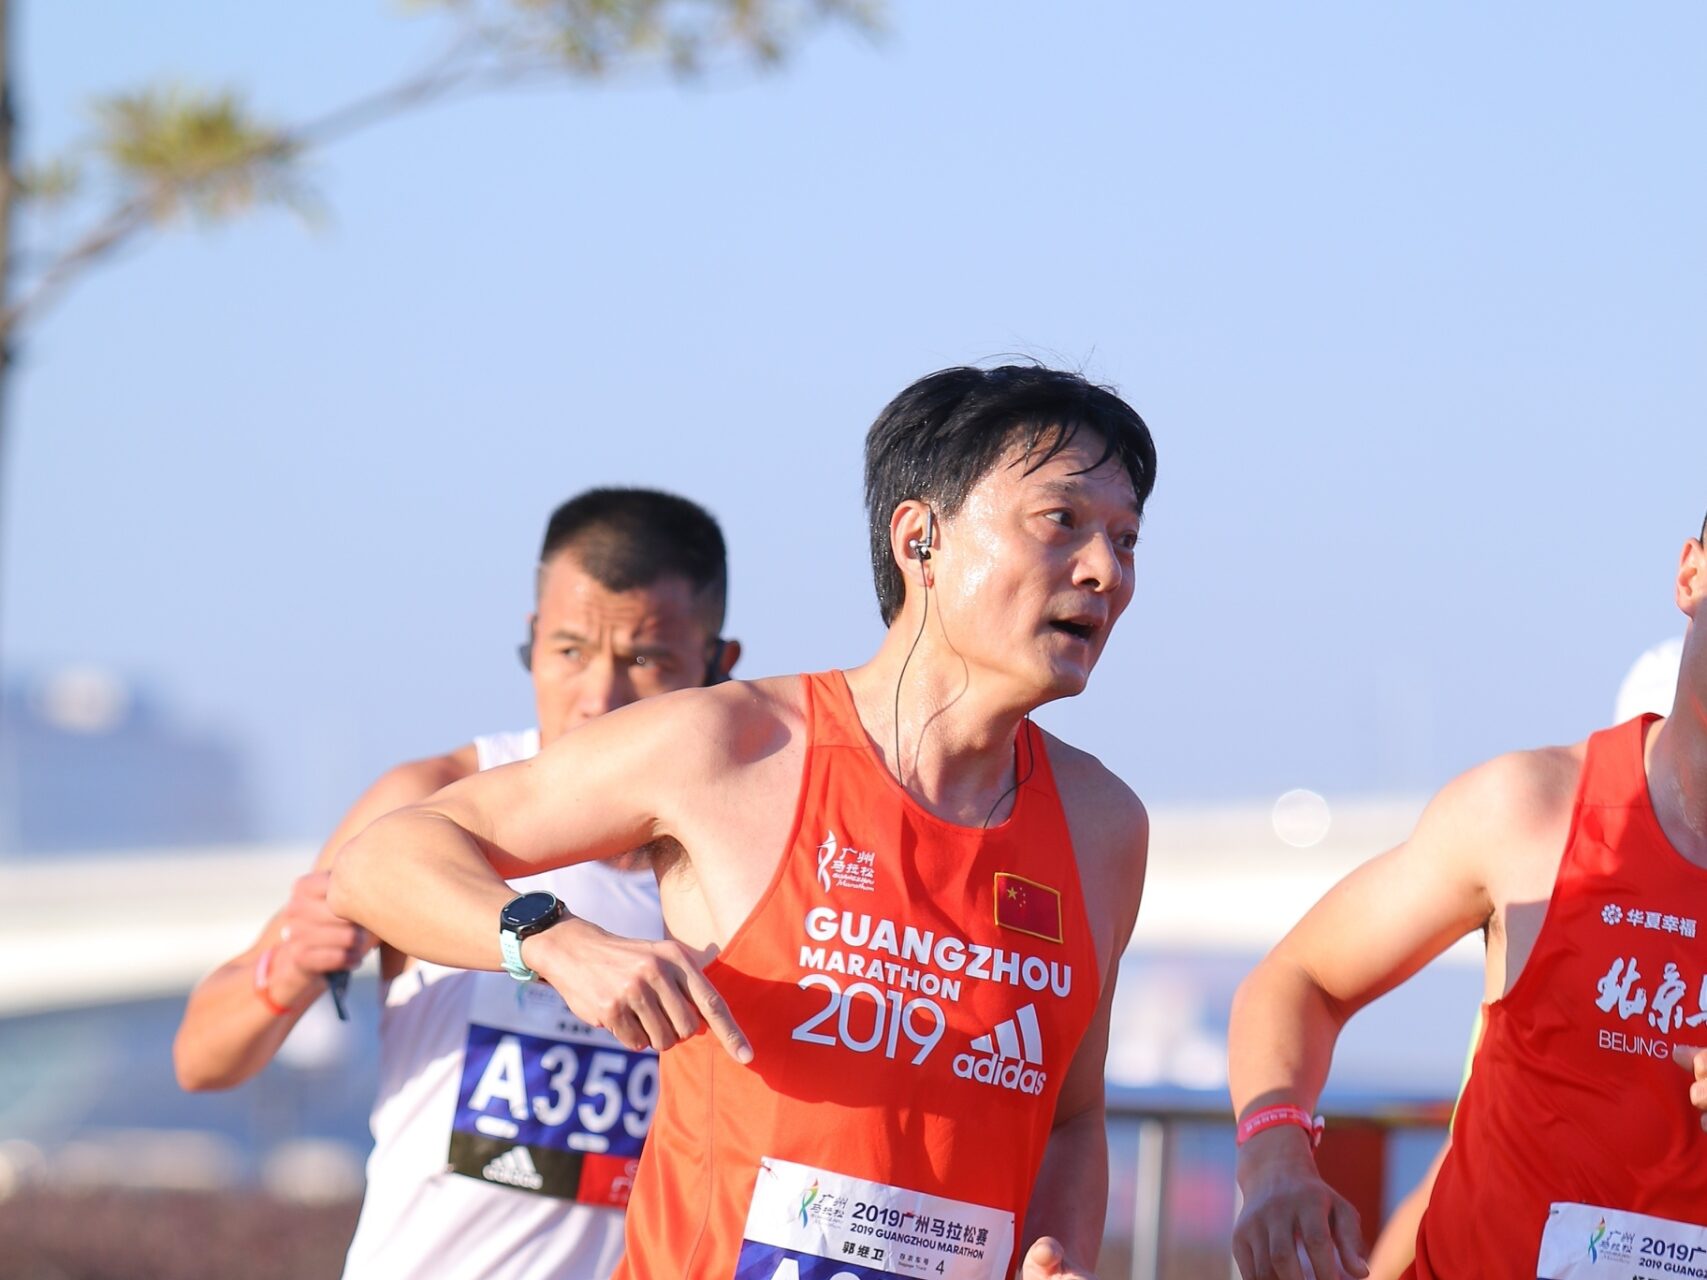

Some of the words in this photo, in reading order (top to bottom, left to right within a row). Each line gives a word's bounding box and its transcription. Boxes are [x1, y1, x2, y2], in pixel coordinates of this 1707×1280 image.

[831, 860, 875, 878] 马拉松
[838, 847, 876, 867] 广州
[1626, 908, 1698, 938] 华夏幸福
[805, 906, 1072, 998] GUANGZHOU
[799, 946, 961, 1002] MARATHON
[791, 973, 946, 1066] 2019
[1599, 1029, 1669, 1059] BEIJING
[953, 1051, 1047, 1096] adidas
[850, 1222, 874, 1236] 2019
[875, 1228, 937, 1250] GUANGZHOU
[937, 1242, 985, 1260] MARATHON
[852, 1202, 989, 1247] 2019广州马拉松赛
[935, 1260, 945, 1275] 4
[1639, 1257, 1662, 1269] 2019
